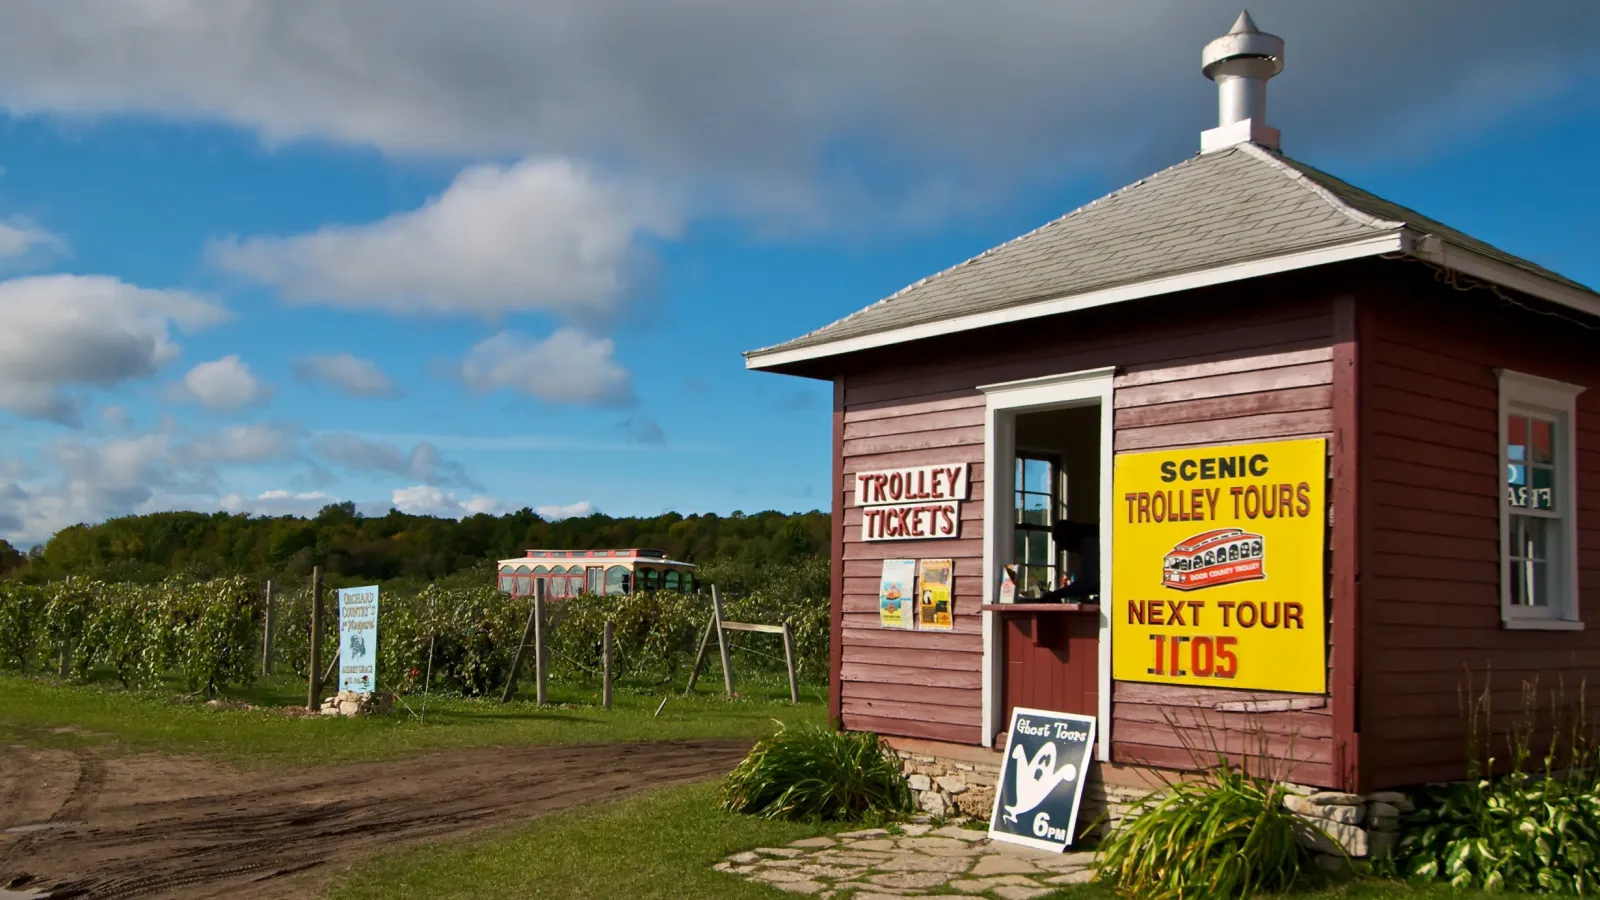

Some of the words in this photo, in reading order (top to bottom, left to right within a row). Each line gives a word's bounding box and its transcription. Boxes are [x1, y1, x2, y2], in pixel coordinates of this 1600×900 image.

[1161, 453, 1269, 483] SCENIC
[858, 467, 961, 502] TROLLEY
[1125, 487, 1221, 524] TROLLEY
[1230, 482, 1311, 519] TOURS
[864, 505, 954, 538] TICKETS
[1128, 600, 1205, 626] NEXT
[1218, 601, 1304, 629] TOUR
[1017, 718, 1051, 737] Ghost
